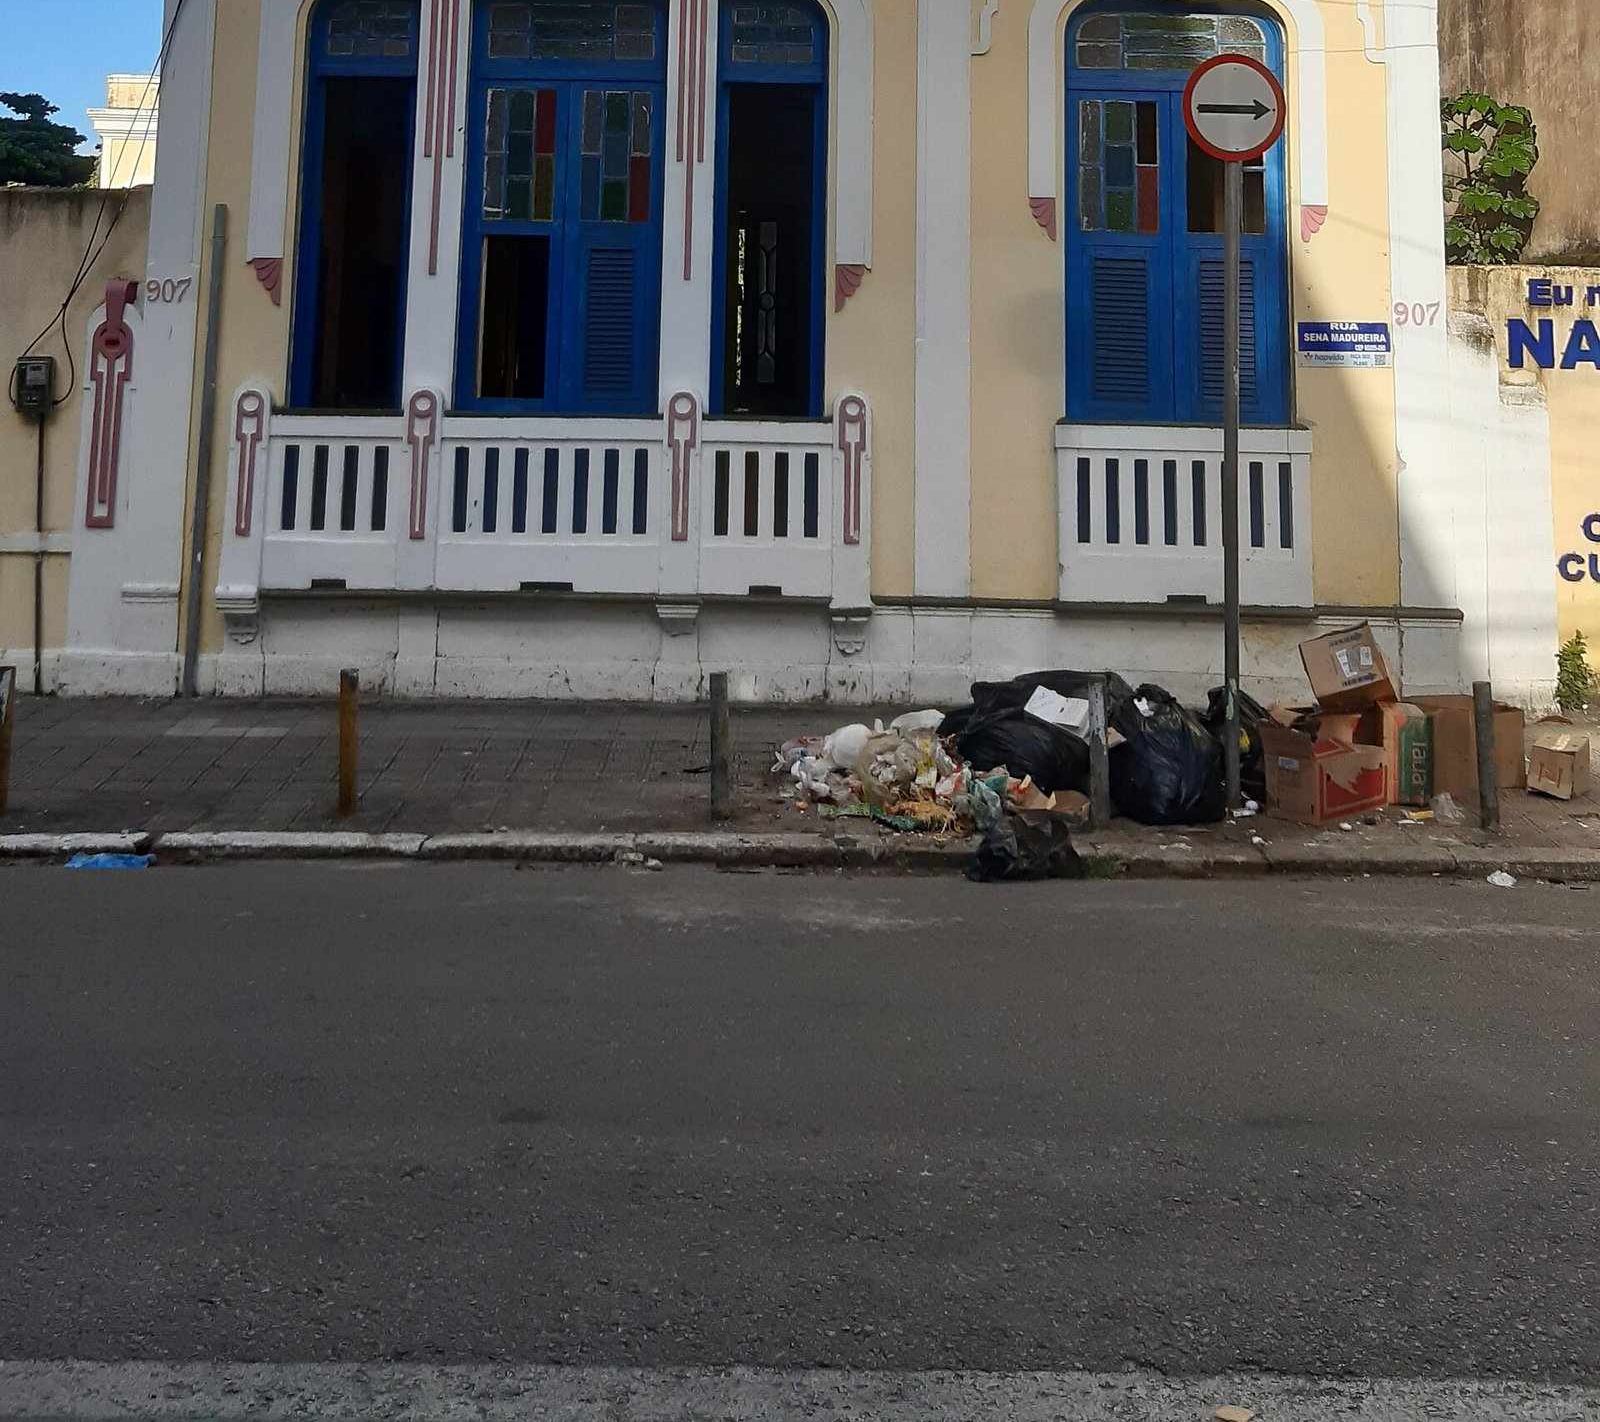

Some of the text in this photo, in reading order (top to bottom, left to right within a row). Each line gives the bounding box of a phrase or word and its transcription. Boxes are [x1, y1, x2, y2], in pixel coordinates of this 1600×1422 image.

[147, 277, 192, 303] 907
[1528, 278, 1573, 306] Eu
[1330, 322, 1359, 331] RUA
[1393, 300, 1440, 327] 907
[1303, 333, 1387, 343] SENA MADUREIRA
[1507, 318, 1600, 370] NA
